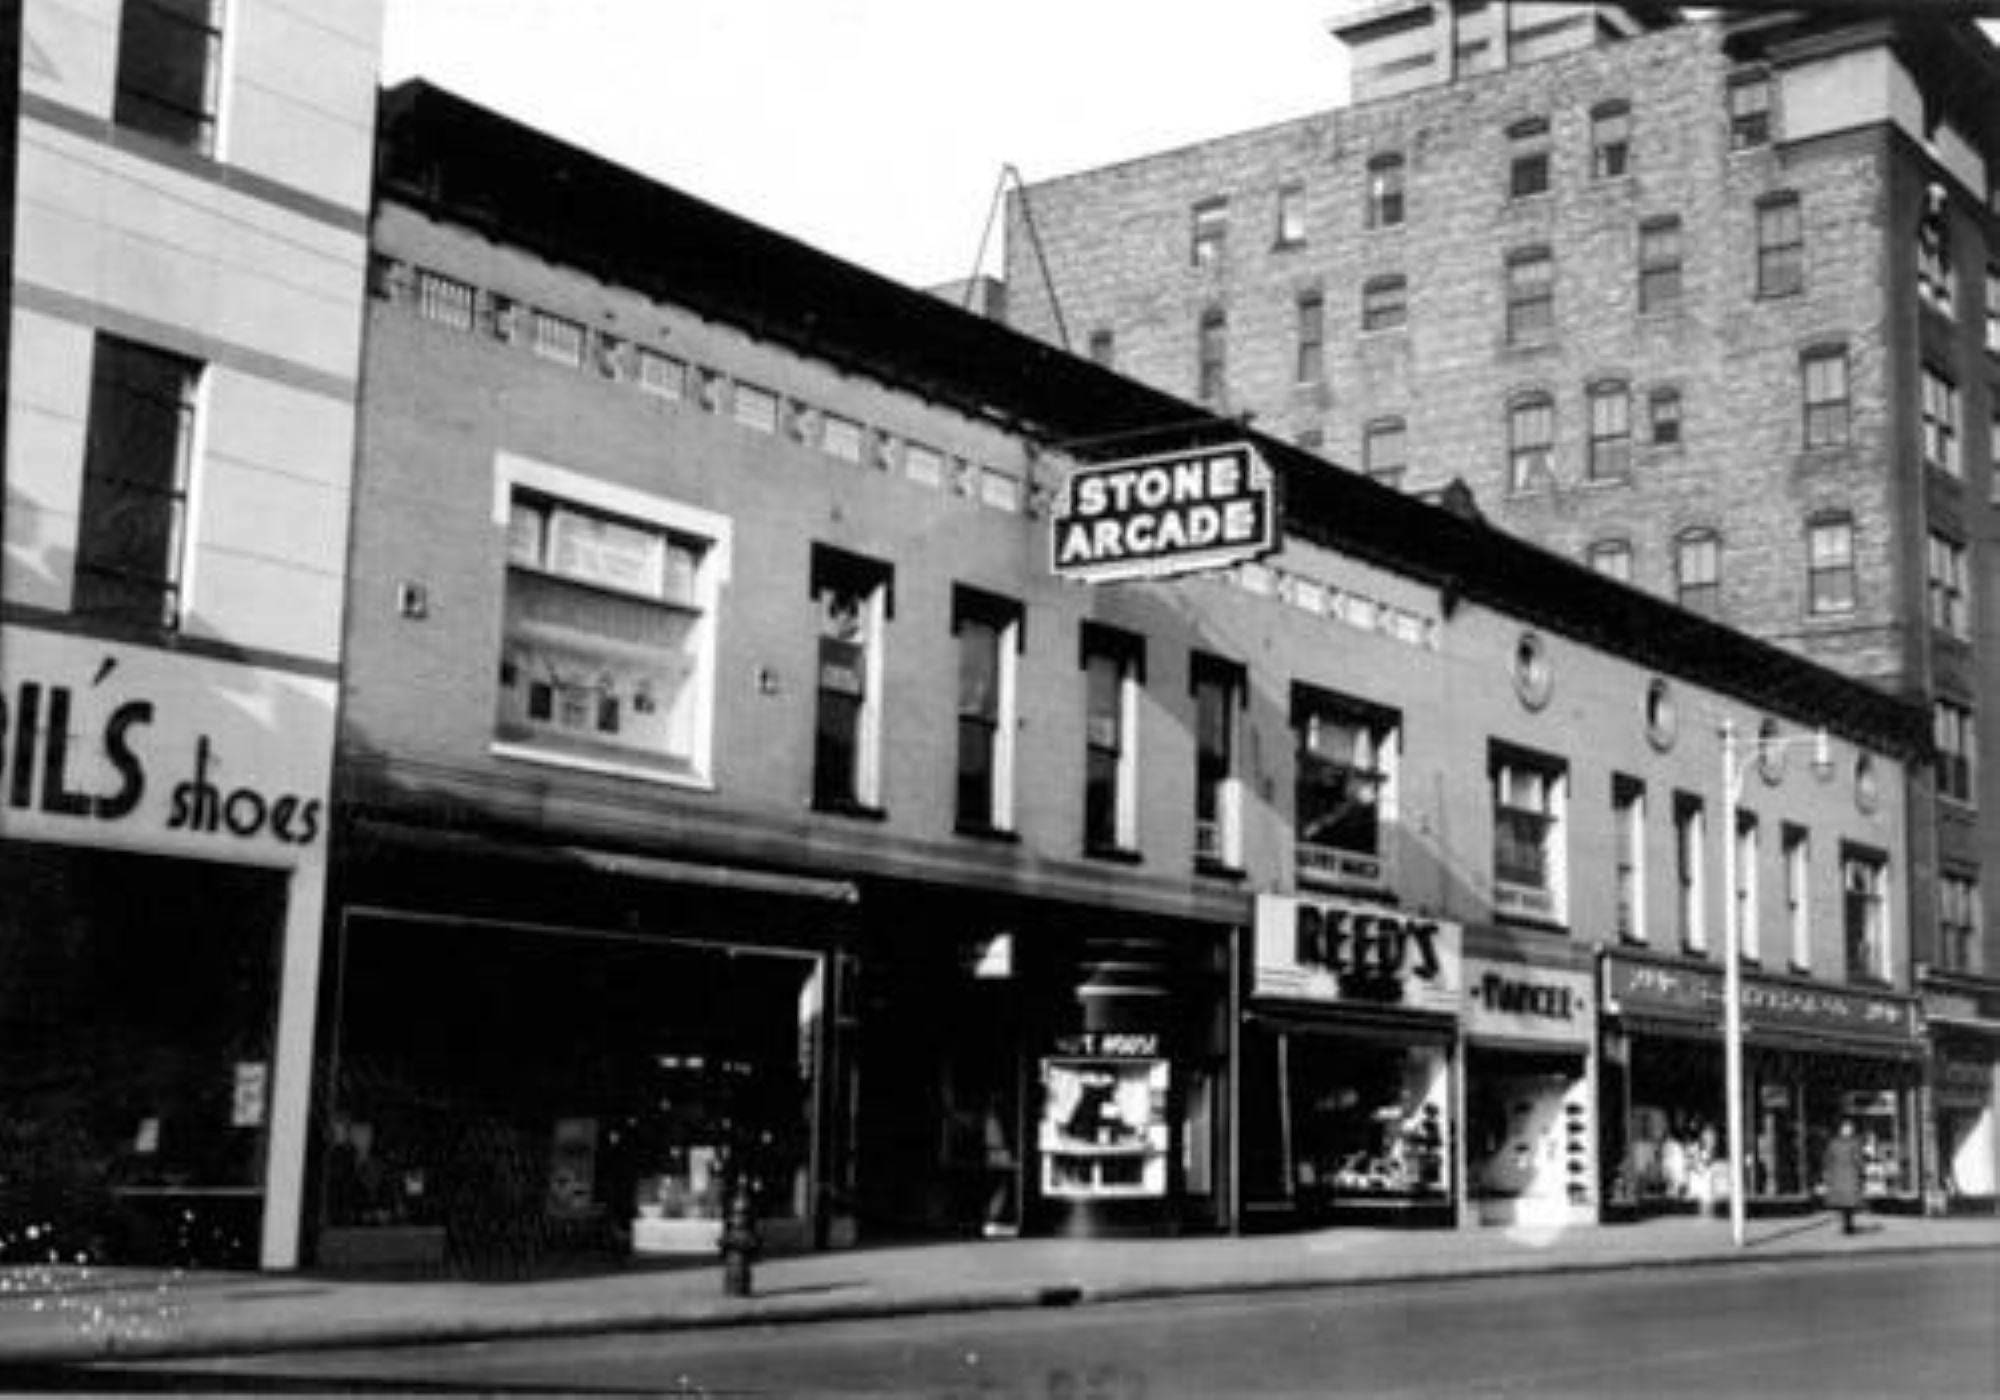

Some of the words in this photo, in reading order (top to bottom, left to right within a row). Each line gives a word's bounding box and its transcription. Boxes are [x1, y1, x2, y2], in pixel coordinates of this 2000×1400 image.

[1077, 456, 1240, 516] STONE
[1060, 499, 1256, 562] ARCADE
[0, 656, 155, 820] IL'S
[166, 734, 321, 846] shoes
